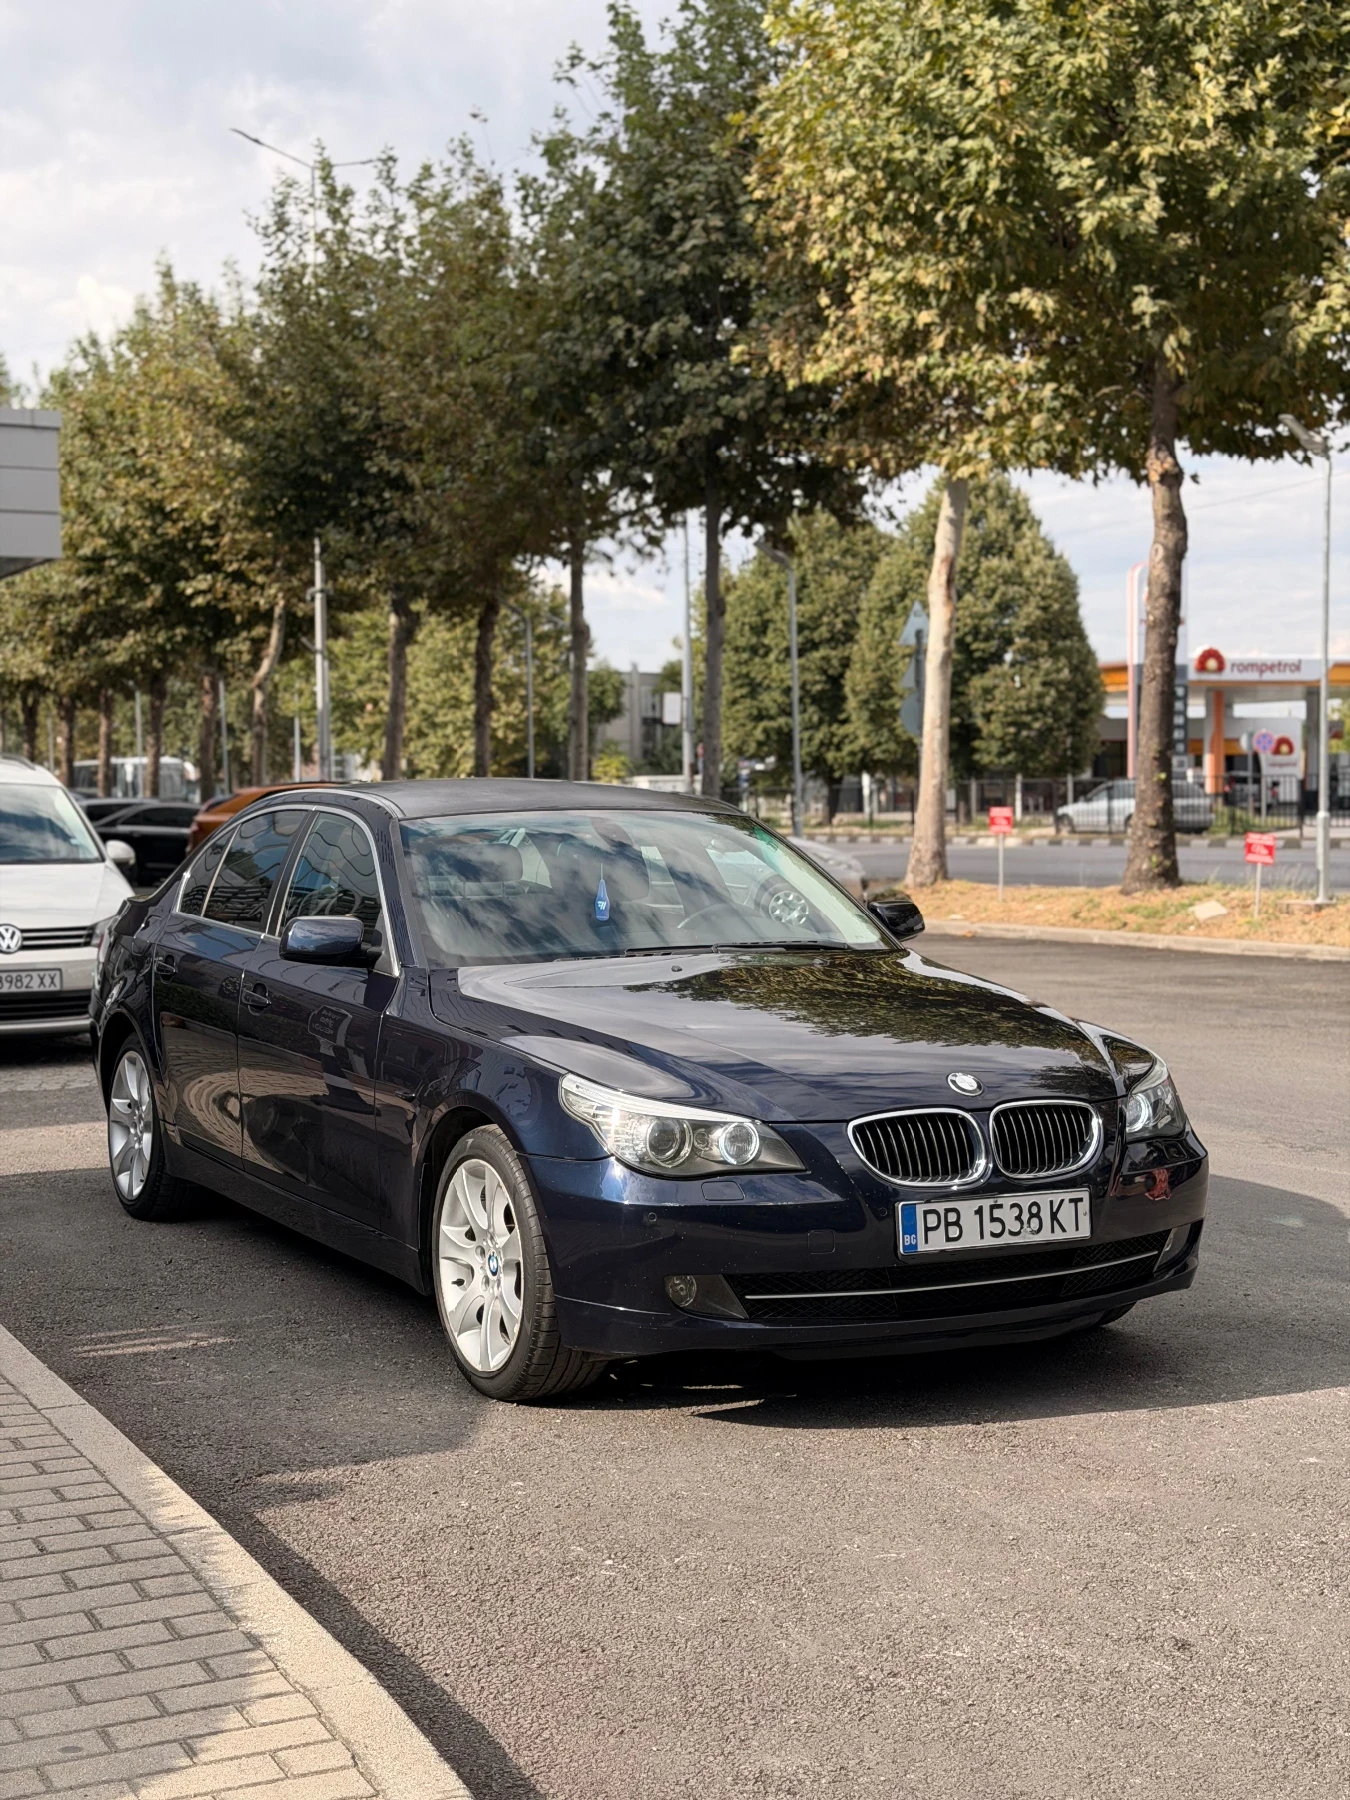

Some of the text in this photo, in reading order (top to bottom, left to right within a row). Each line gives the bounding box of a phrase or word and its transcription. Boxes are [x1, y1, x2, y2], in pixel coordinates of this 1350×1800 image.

[1230, 659, 1301, 678] rompetrol
[37, 972, 57, 989] XX
[922, 1197, 1084, 1244] PB 1538 KT
[904, 1234, 916, 1246] BG
